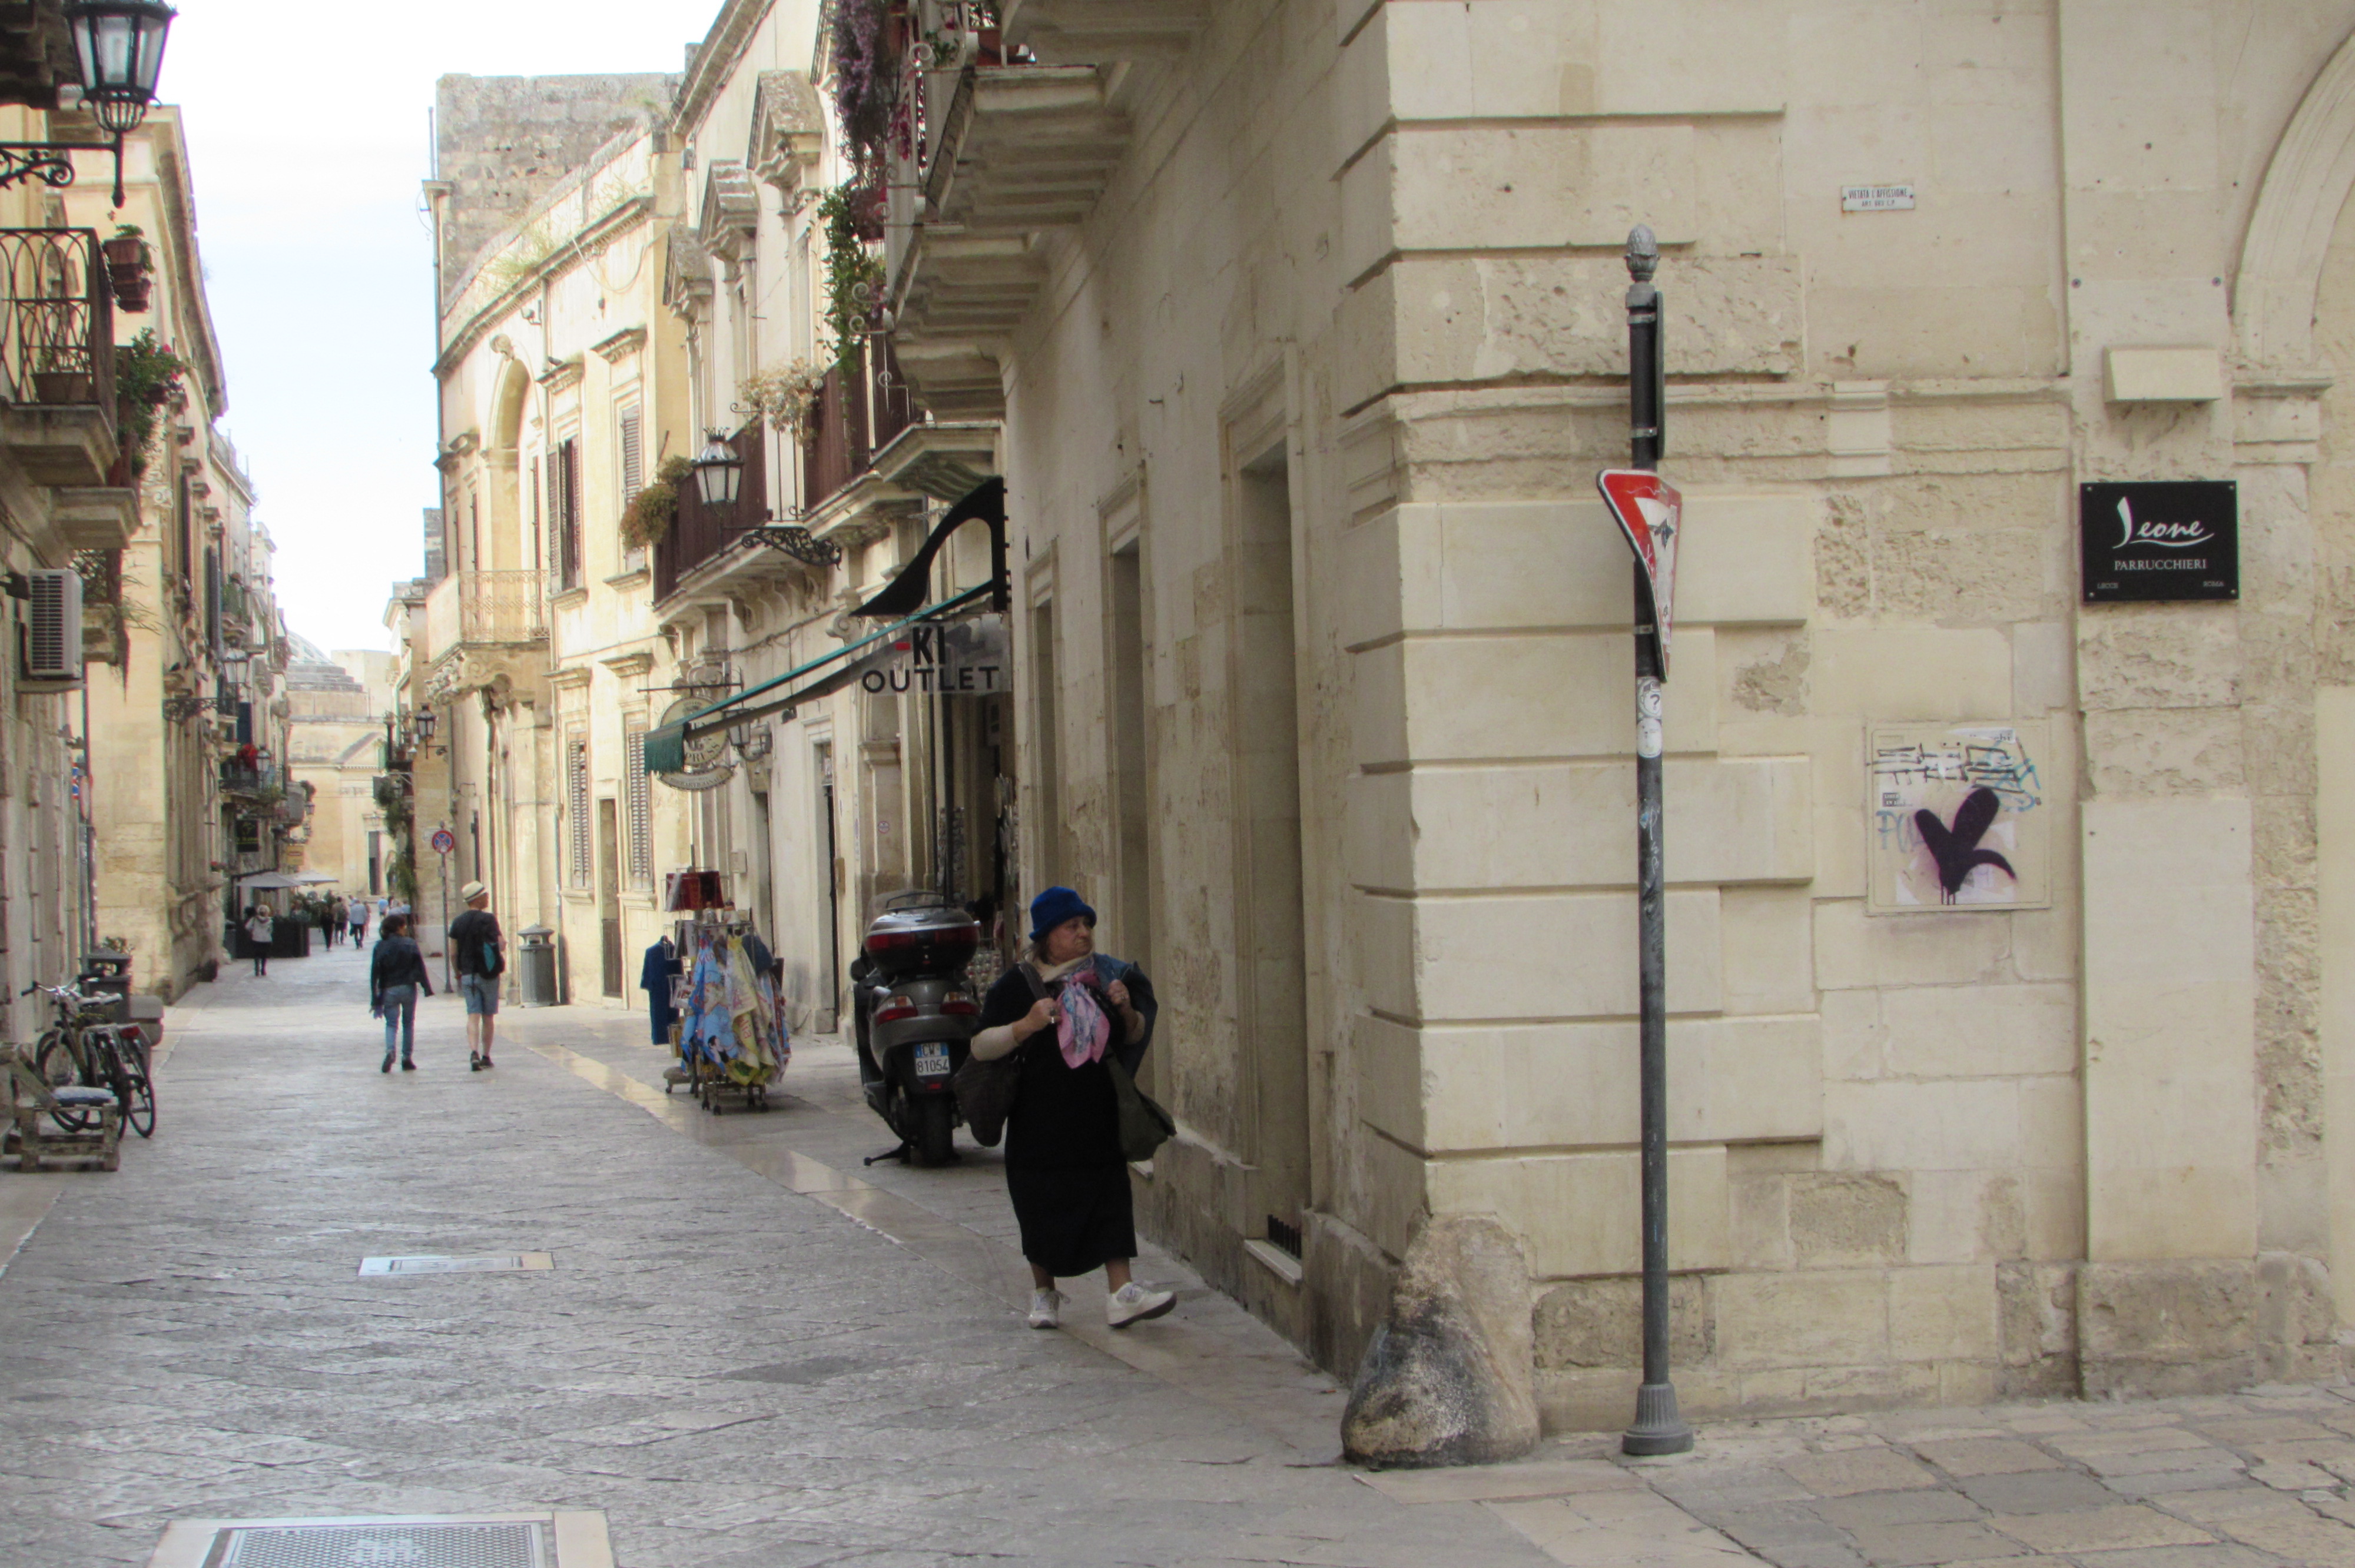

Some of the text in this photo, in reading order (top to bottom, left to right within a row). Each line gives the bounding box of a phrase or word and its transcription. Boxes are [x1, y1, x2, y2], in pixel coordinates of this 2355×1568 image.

[1849, 190, 1869, 199] VIETATA
[2112, 496, 2214, 549] Leone
[2114, 559, 2207, 571] PARRUCCHIERI
[862, 666, 999, 693] OUTLET
[923, 1043, 934, 1057] CW
[917, 1059, 949, 1073] 81054
